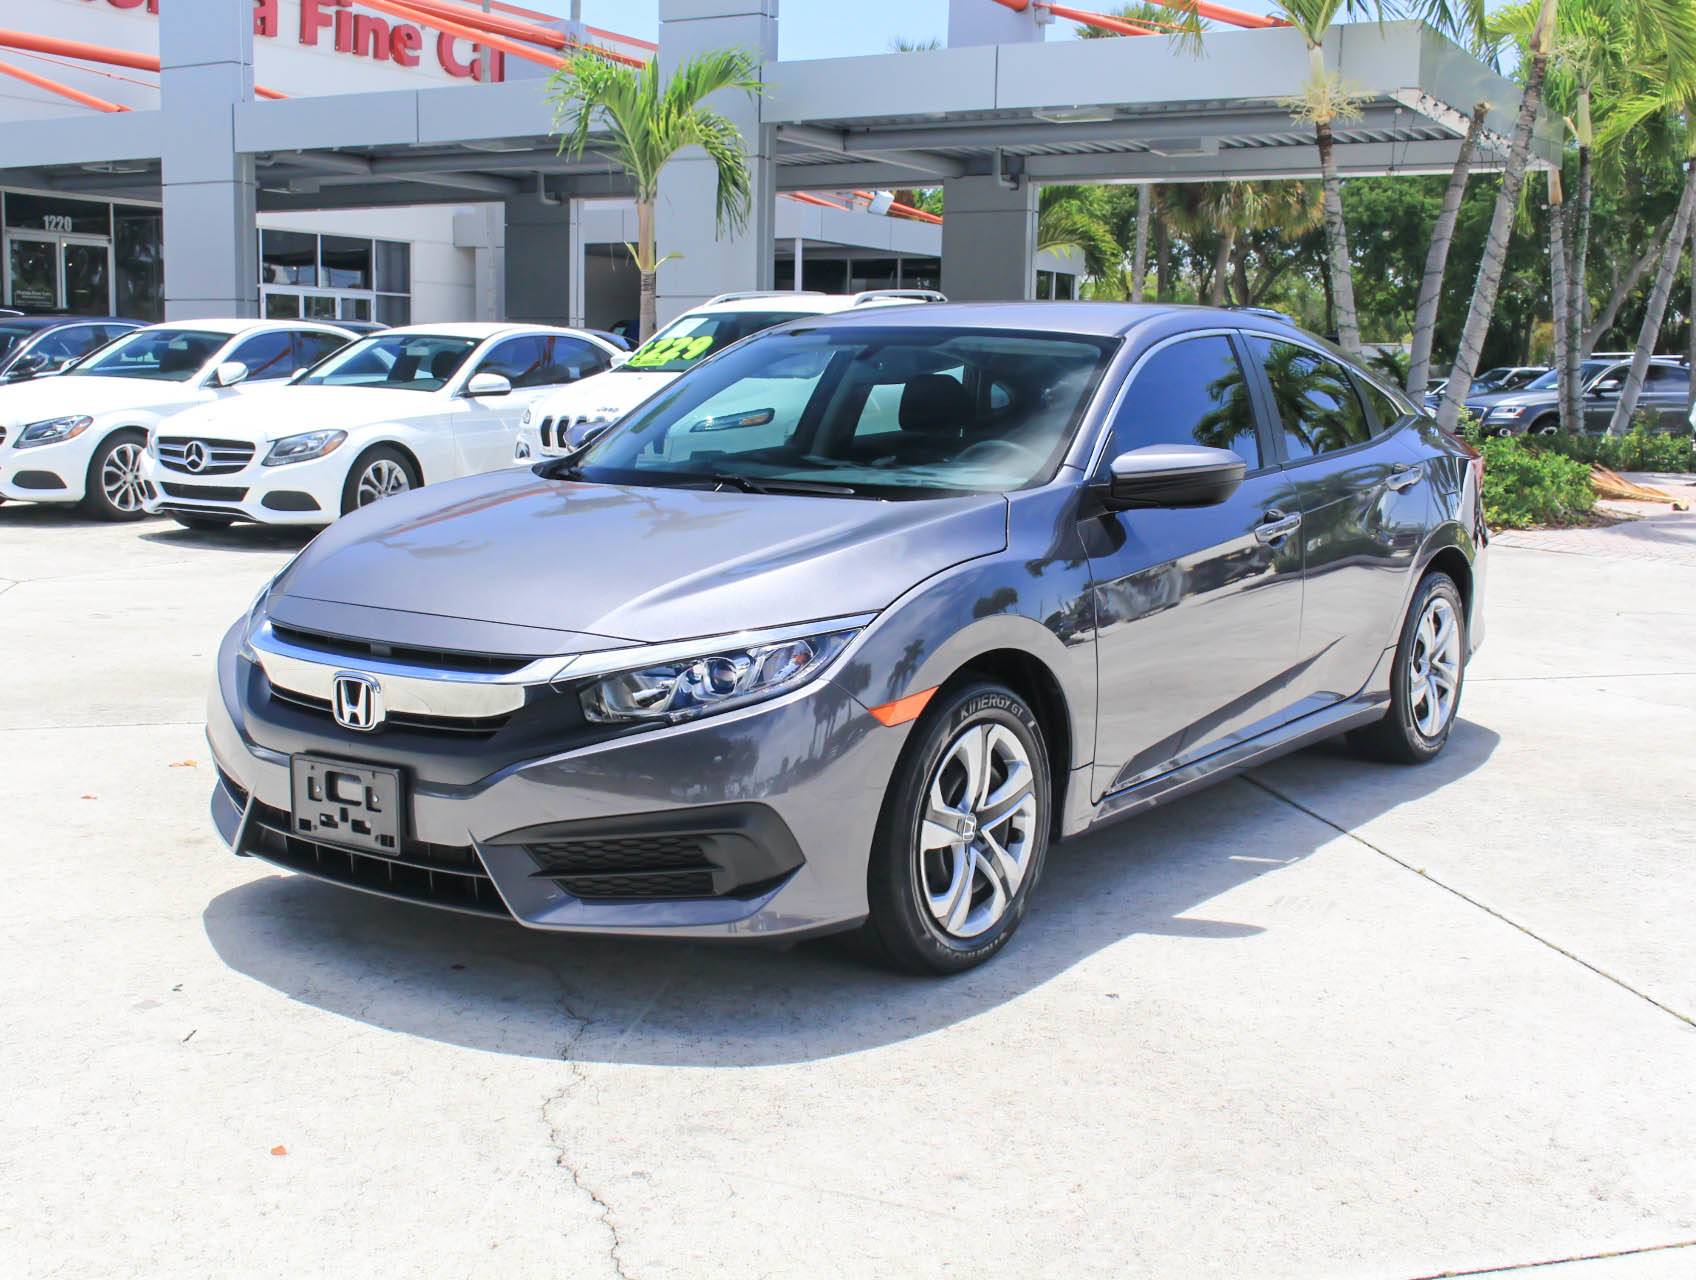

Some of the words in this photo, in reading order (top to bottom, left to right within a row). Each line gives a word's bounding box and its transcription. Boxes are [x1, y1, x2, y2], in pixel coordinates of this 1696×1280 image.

[299, 0, 423, 67] Fine
[43, 214, 72, 232] 1220
[1010, 703, 1024, 718] GT
